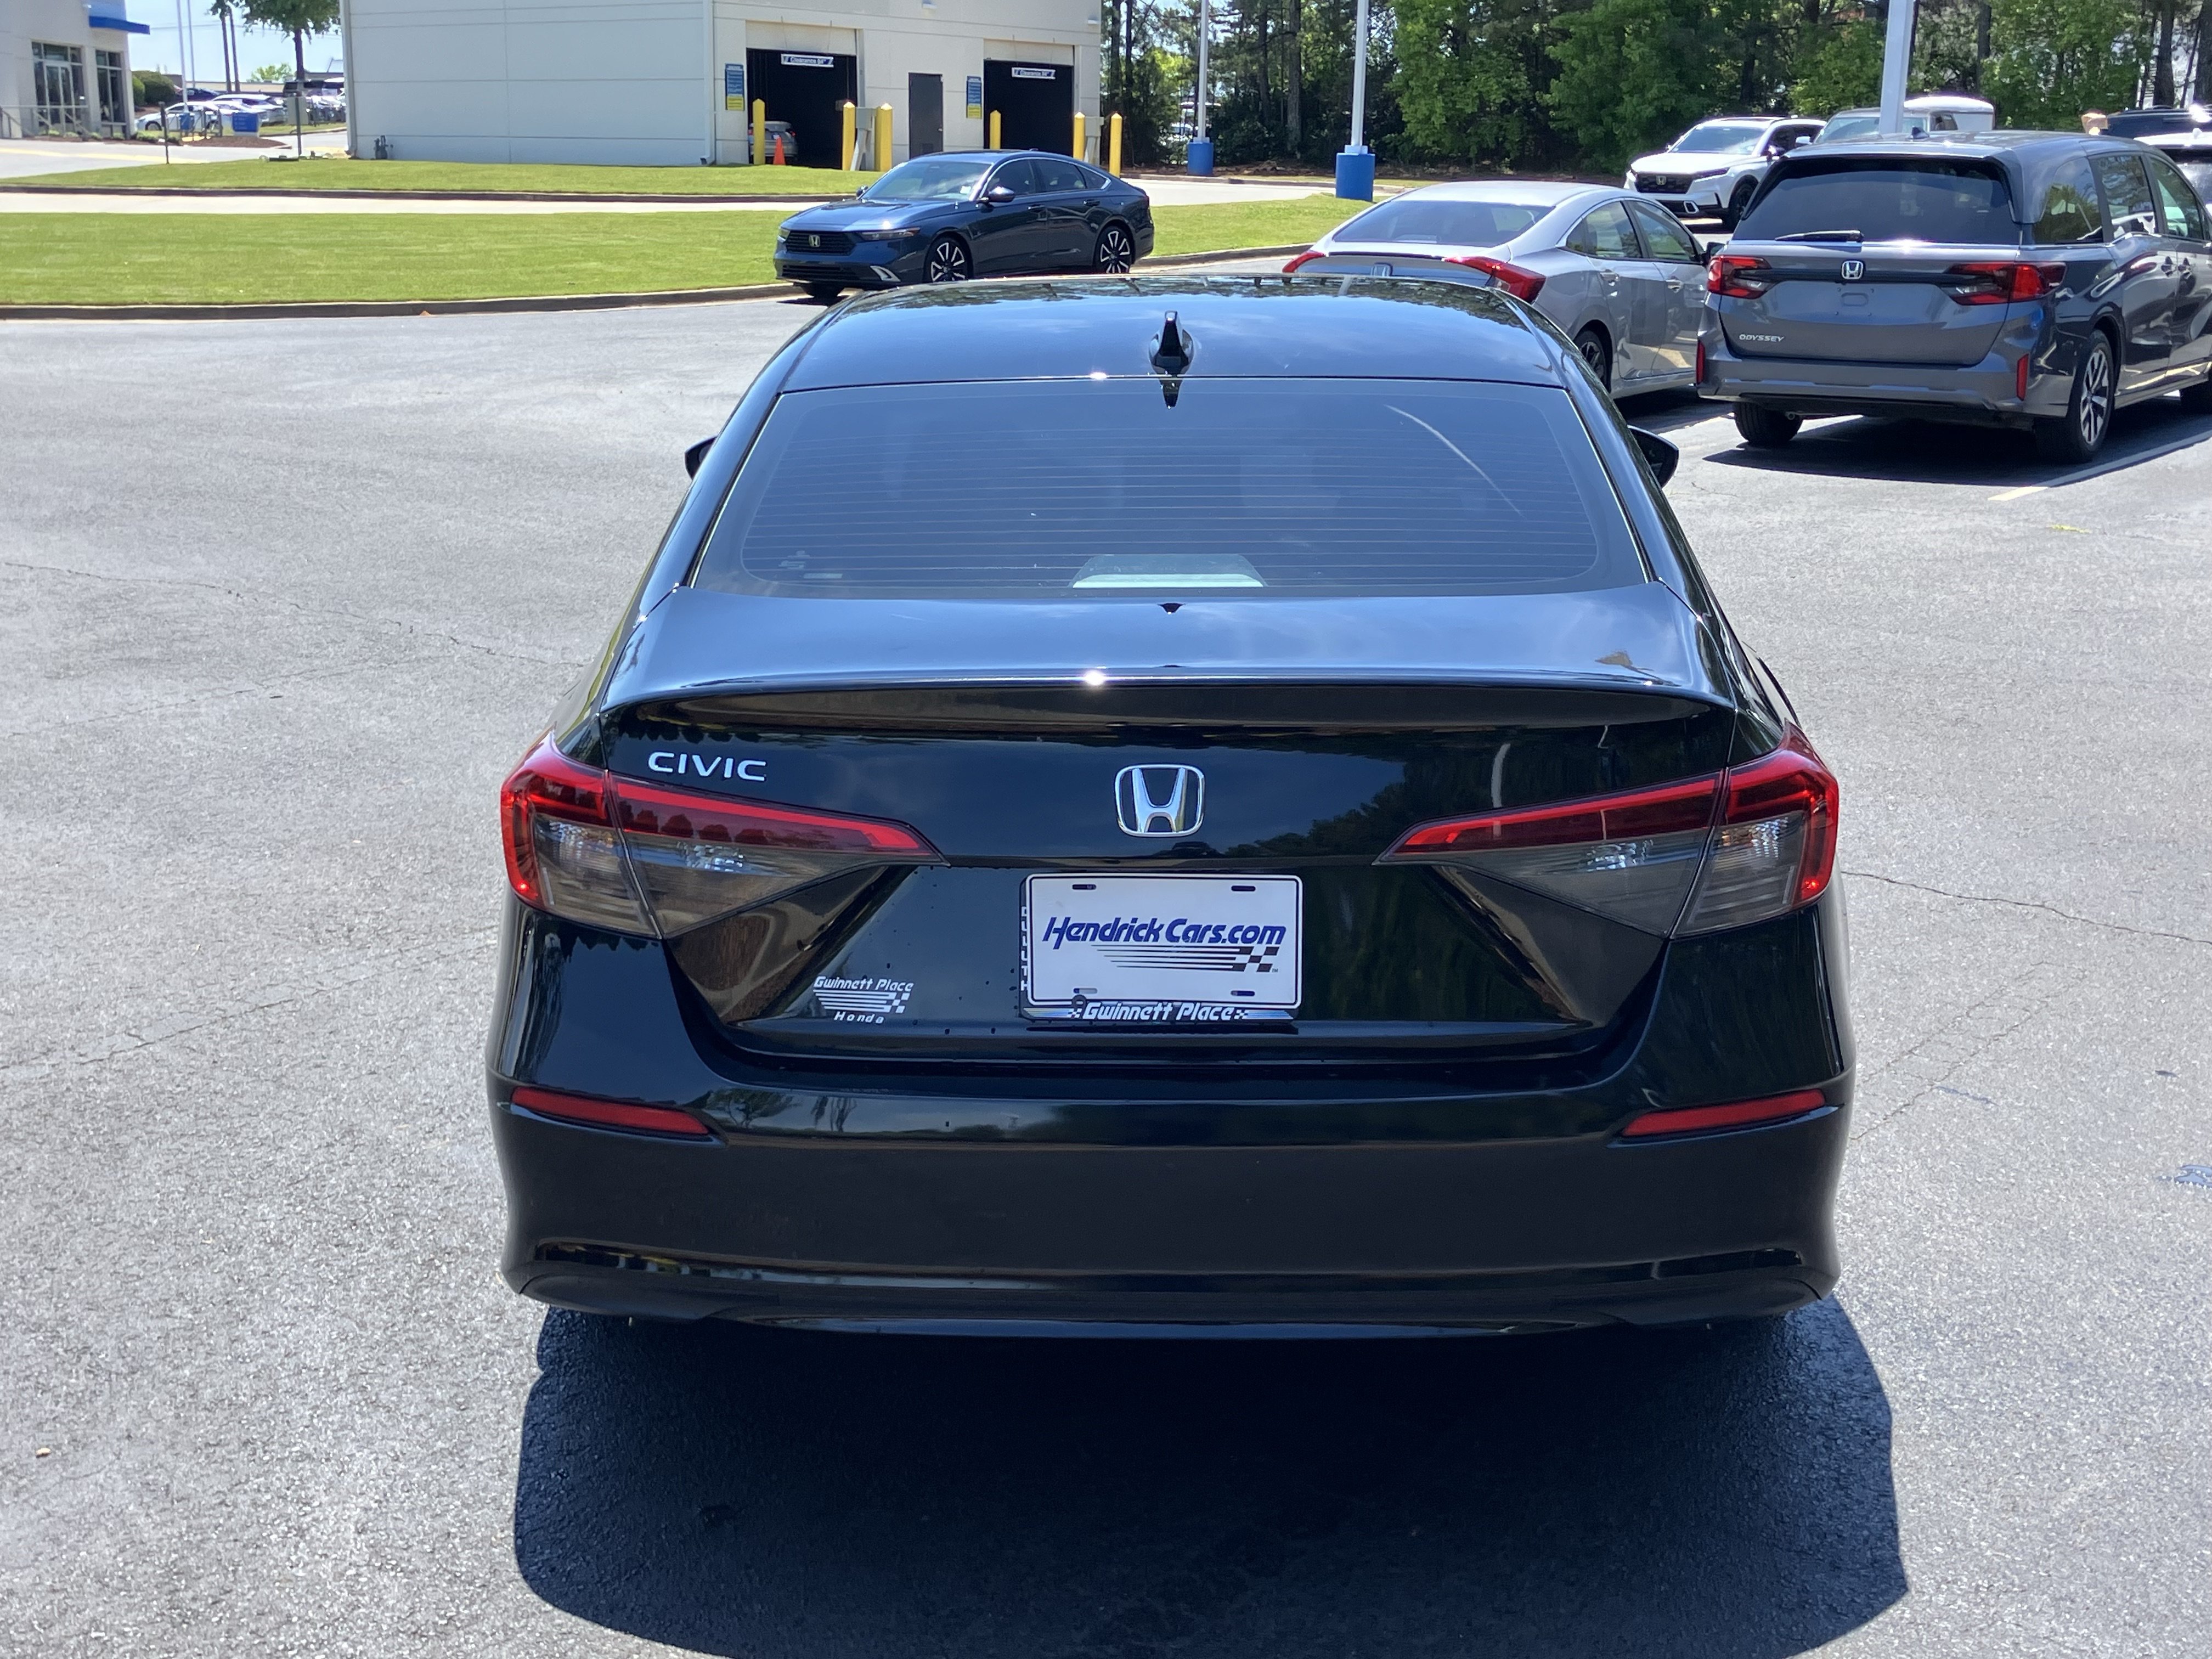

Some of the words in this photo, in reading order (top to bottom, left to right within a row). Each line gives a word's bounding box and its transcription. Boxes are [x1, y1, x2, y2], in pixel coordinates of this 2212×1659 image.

[1739, 334, 1785, 342] ODYSSEY
[648, 752, 766, 781] CIVIC
[1042, 917, 1165, 950] Hendrick
[1165, 918, 1286, 945] Cars.com
[813, 975, 873, 990] Gwinnett
[875, 978, 914, 992] Place
[834, 1011, 885, 1024] Honda
[1082, 1001, 1173, 1020] Gwinnett
[1176, 1002, 1235, 1021] Place
